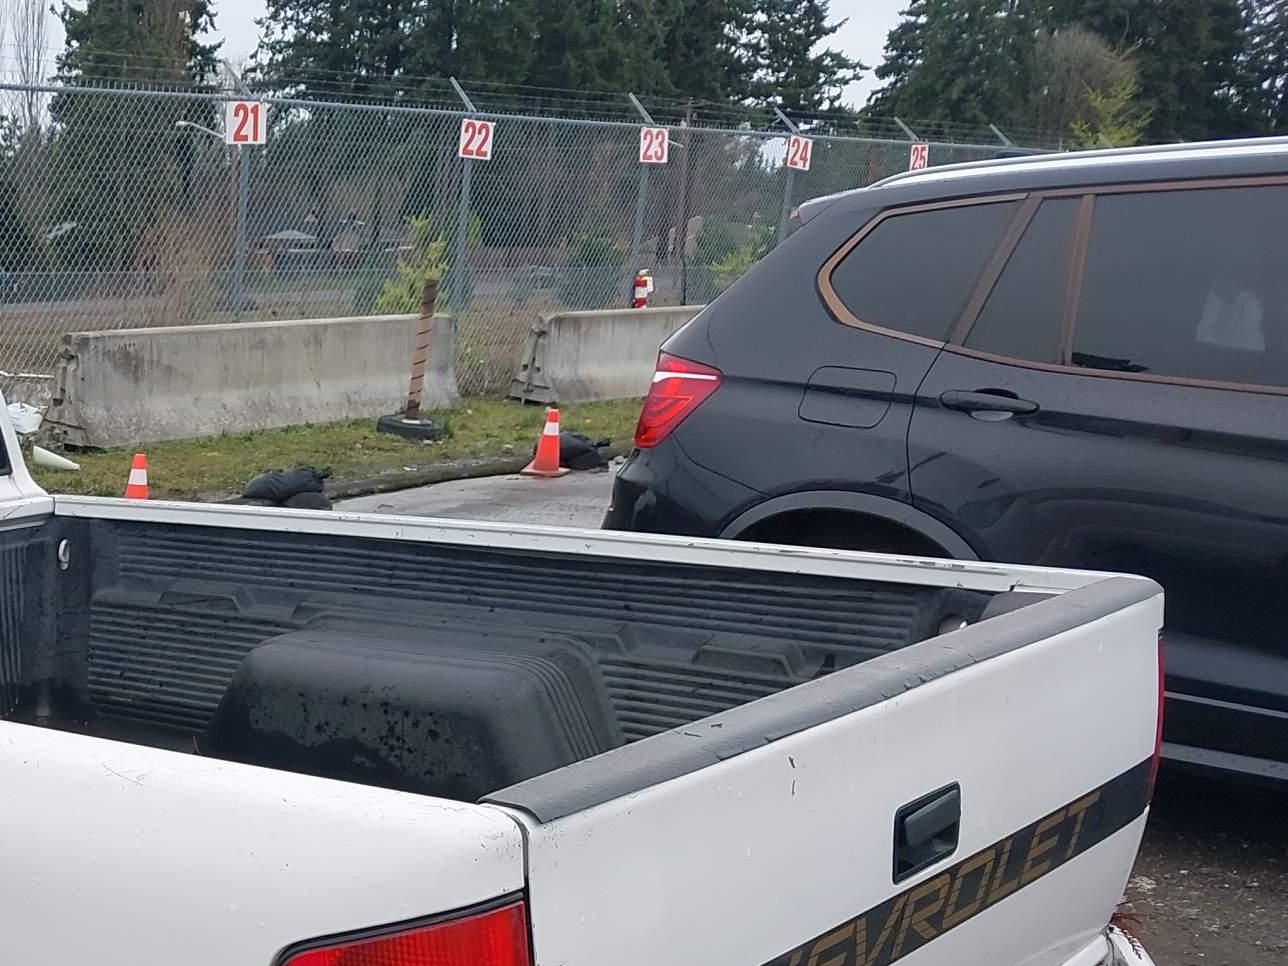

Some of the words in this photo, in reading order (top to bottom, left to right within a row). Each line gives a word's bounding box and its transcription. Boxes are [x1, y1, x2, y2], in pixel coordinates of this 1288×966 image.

[233, 103, 260, 142] 21
[462, 121, 490, 157] 22
[642, 130, 666, 161] 23
[789, 138, 809, 169] 24
[912, 145, 927, 170] 25
